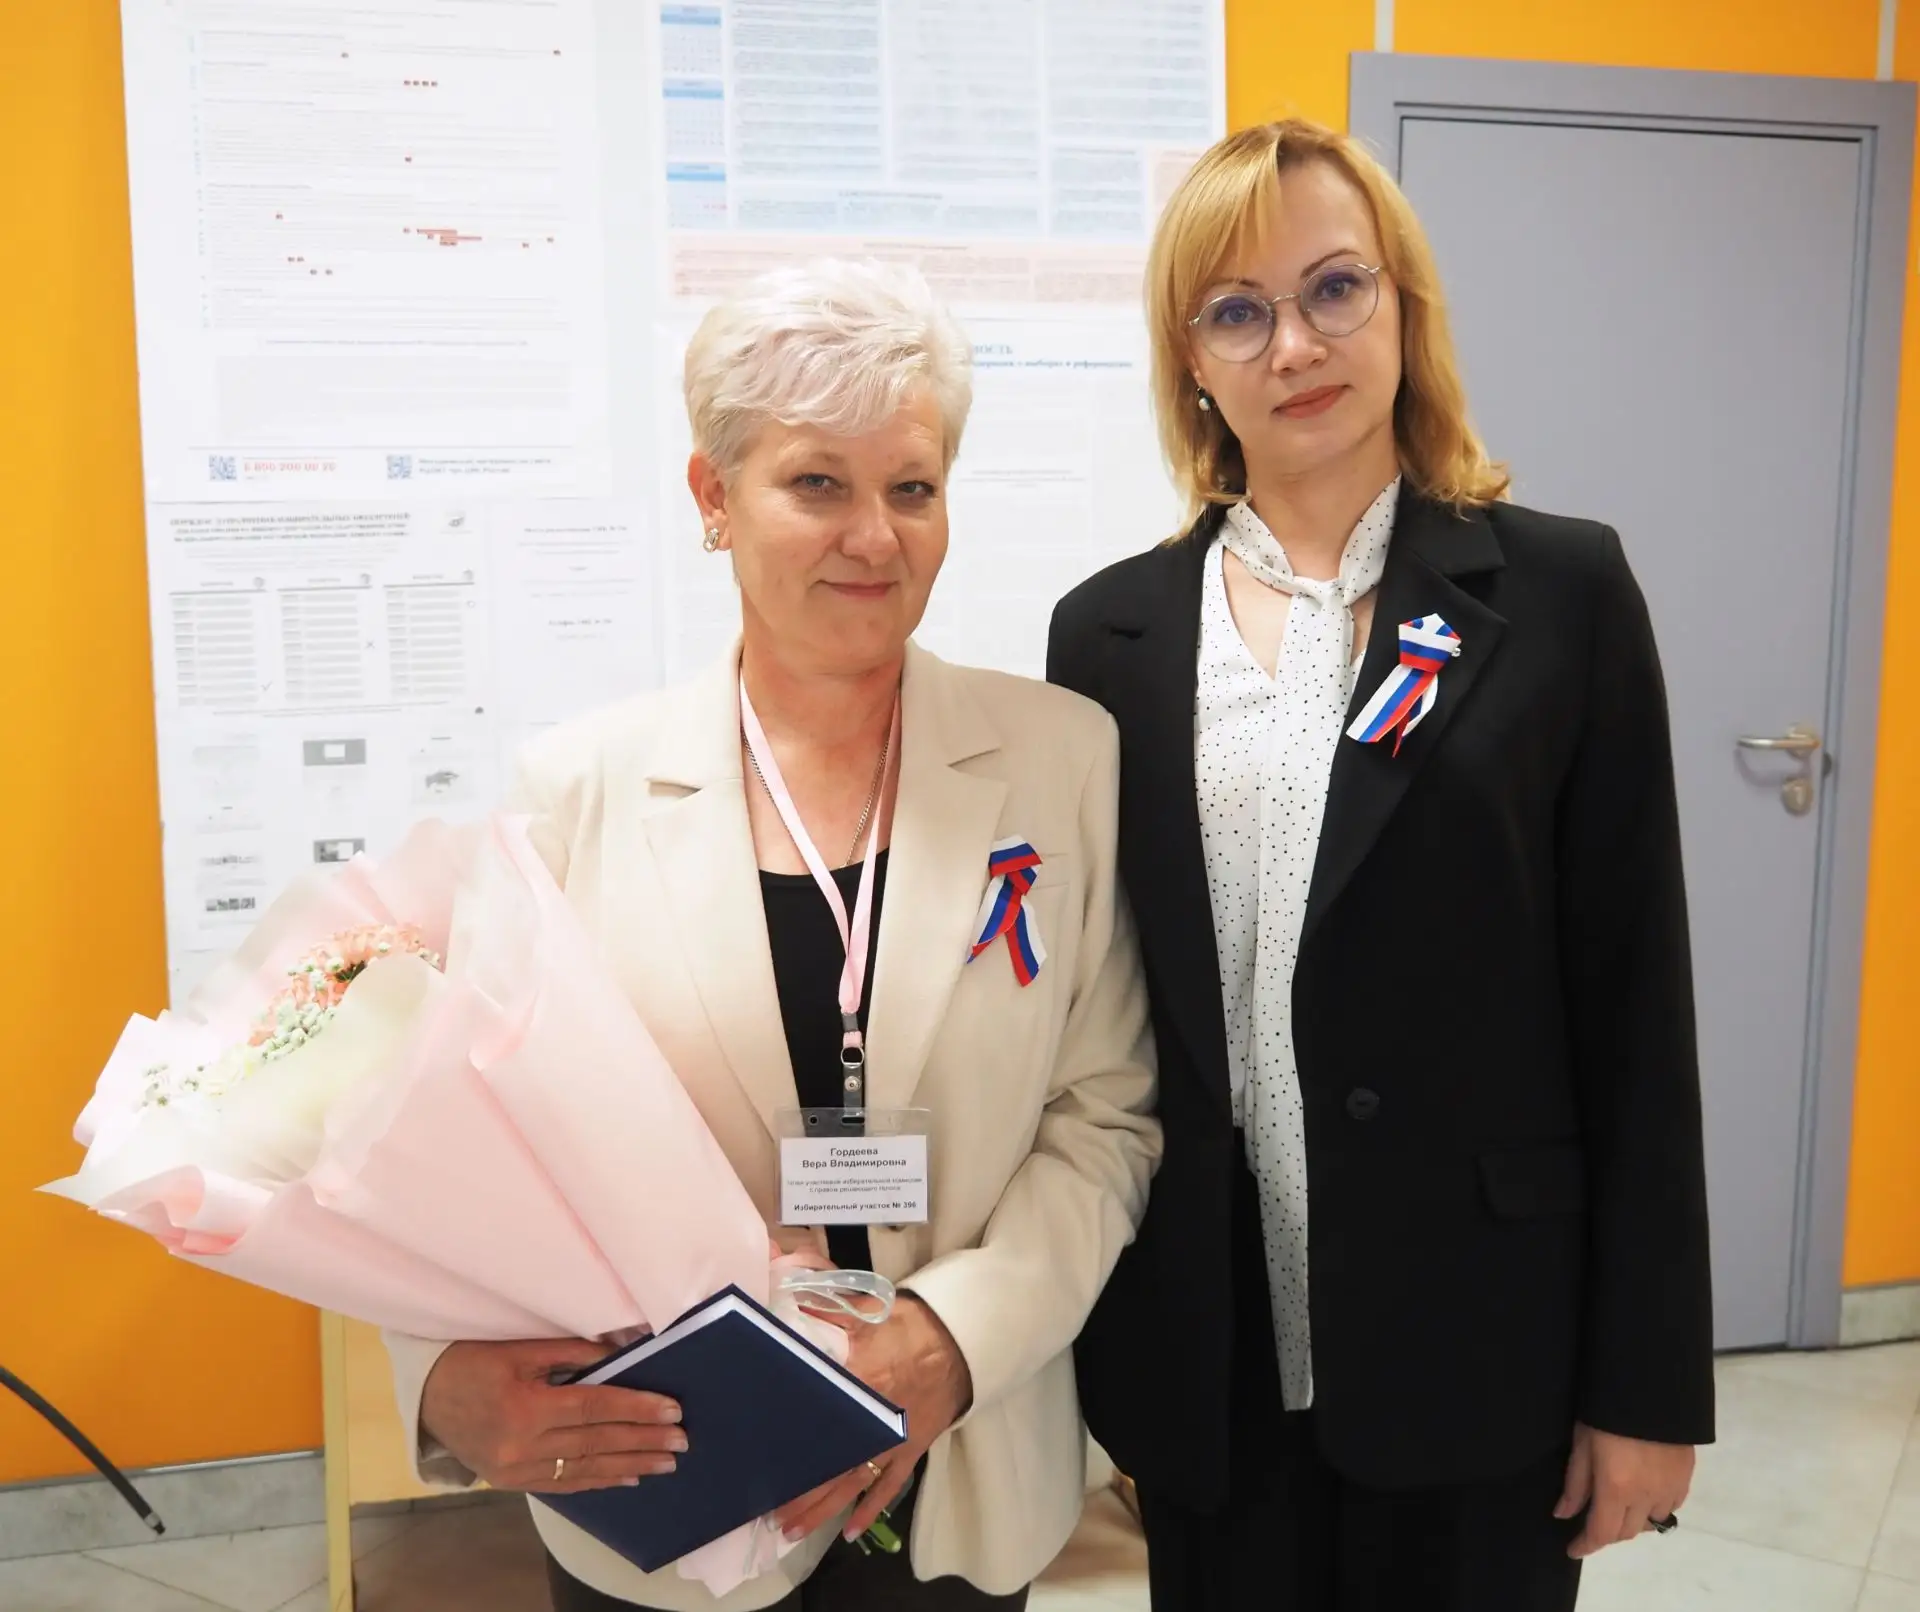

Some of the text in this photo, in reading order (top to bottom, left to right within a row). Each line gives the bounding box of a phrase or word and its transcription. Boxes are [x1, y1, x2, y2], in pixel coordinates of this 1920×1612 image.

[830, 1147, 878, 1157] Гордеева
[802, 1158, 907, 1169] Вера Владимировна
[794, 1202, 858, 1212] Избирательный
[859, 1202, 891, 1212] участок
